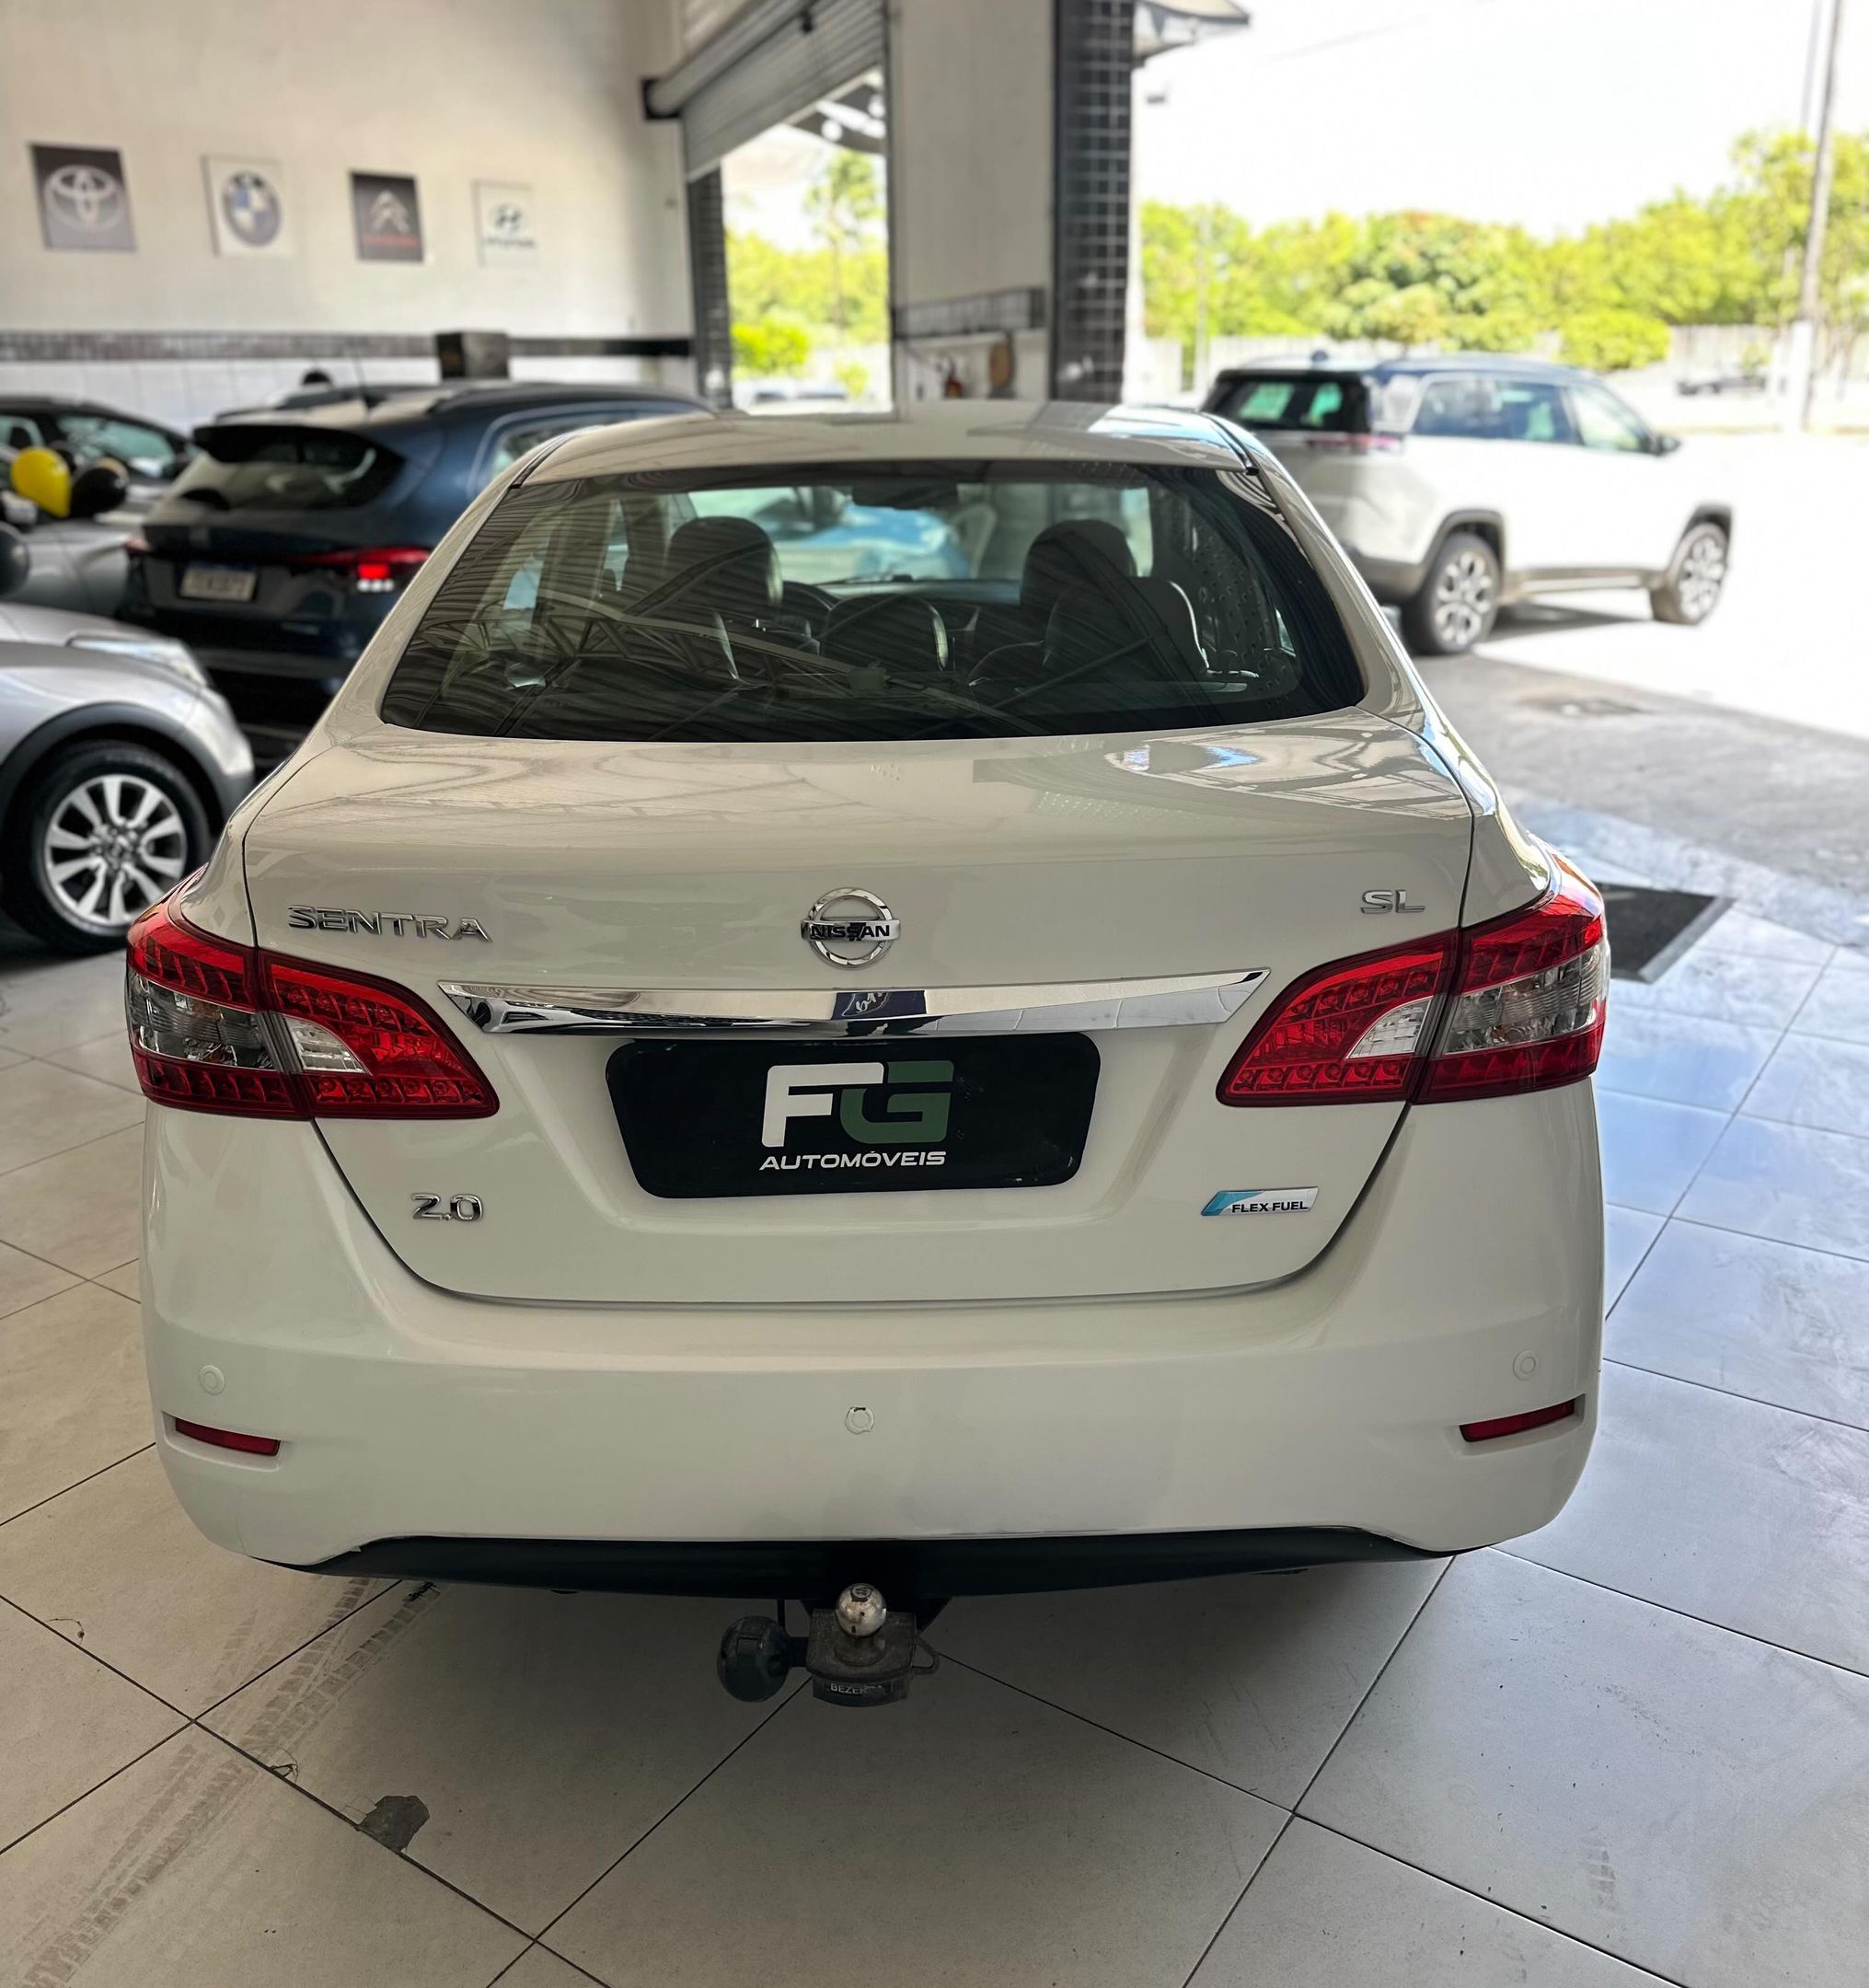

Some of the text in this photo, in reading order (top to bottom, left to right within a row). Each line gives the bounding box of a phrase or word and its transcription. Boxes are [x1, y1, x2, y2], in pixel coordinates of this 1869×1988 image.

[1360, 889, 1425, 915] SL
[287, 905, 492, 942] SENTRA
[809, 923, 891, 937] NISSAN
[762, 1061, 954, 1148] FG
[759, 1150, 947, 1171] AUTOMÓVEIS
[412, 1193, 483, 1222] 2.0
[1231, 1201, 1308, 1213] FLEX FUEL
